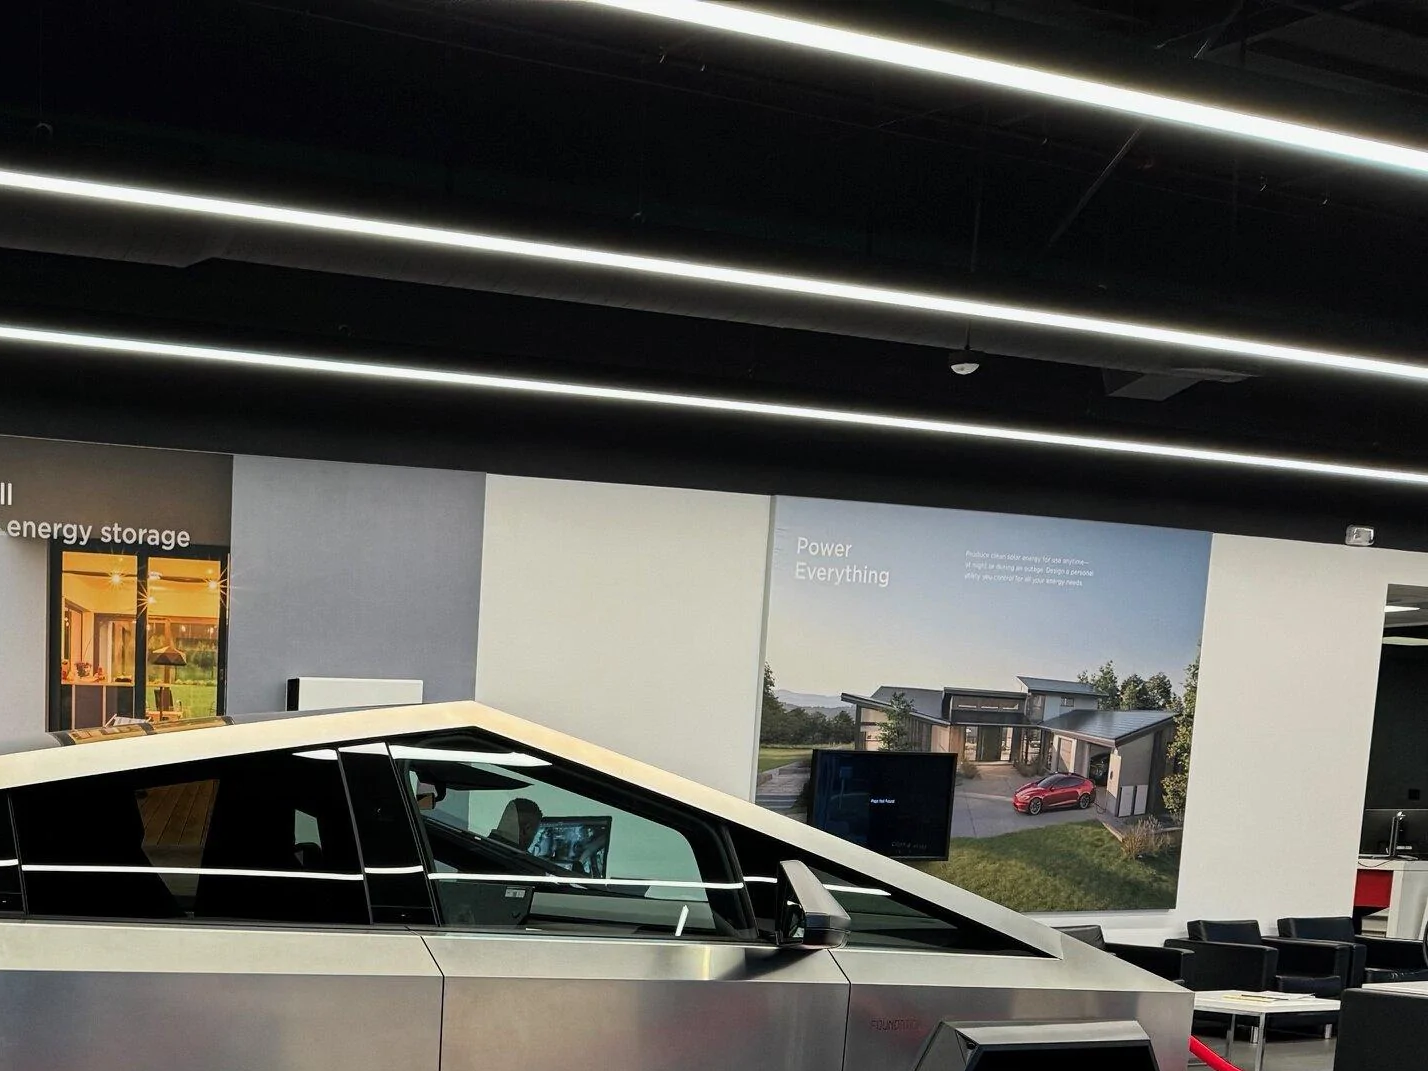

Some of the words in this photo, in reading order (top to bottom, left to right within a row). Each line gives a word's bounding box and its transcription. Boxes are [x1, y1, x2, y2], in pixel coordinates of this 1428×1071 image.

[7, 520, 92, 545] energy
[100, 522, 190, 550] storage
[797, 536, 852, 557] Power
[795, 562, 890, 587] Everything
[1046, 567, 1064, 575] Design
[1070, 569, 1093, 577] personal
